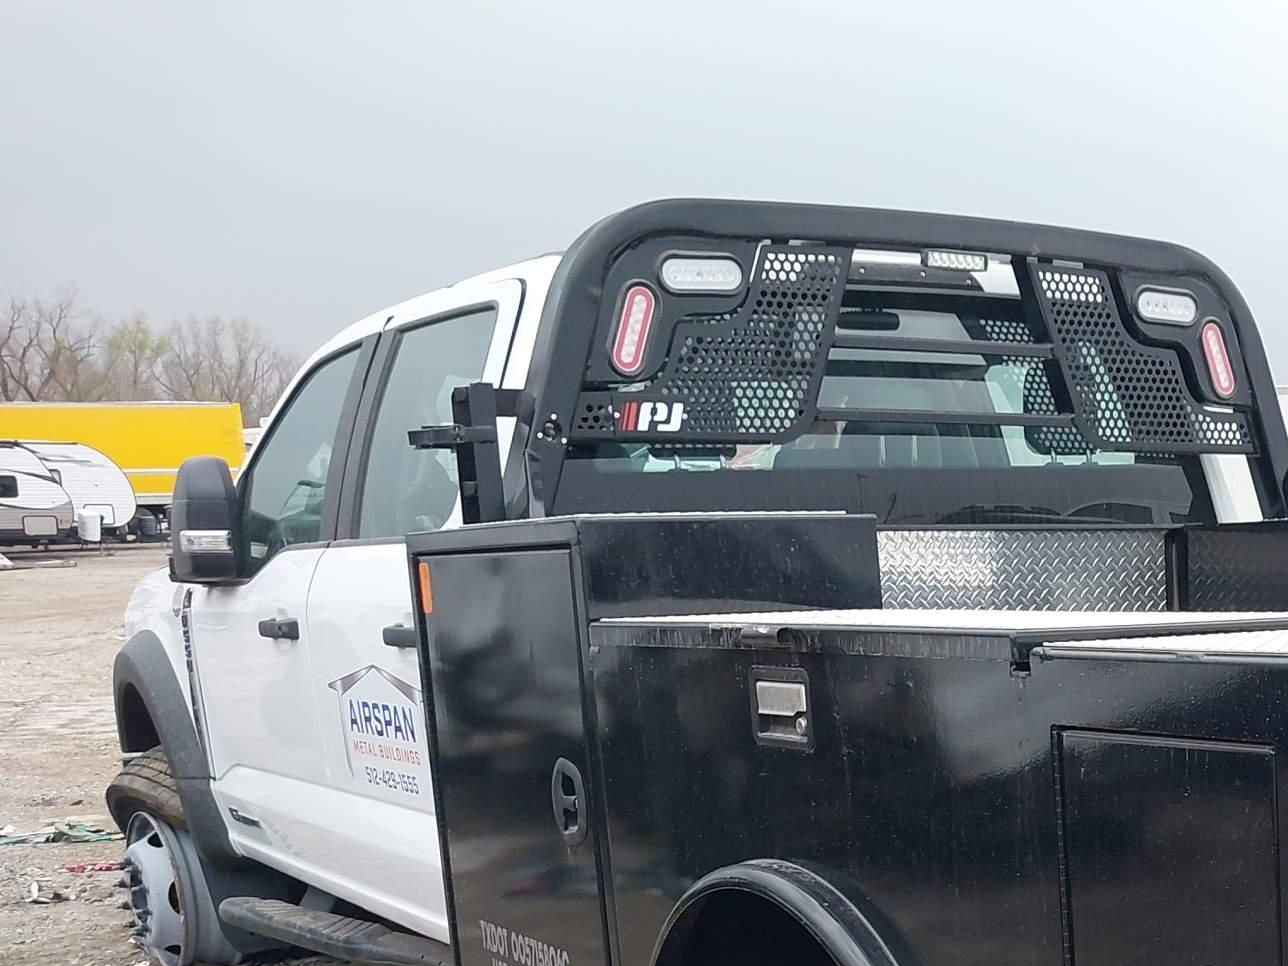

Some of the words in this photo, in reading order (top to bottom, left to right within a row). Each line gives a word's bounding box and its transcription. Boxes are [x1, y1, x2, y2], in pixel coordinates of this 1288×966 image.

[637, 401, 684, 432] PJ
[349, 699, 417, 743] AIRSPAN
[352, 739, 378, 757] METAL
[379, 744, 421, 766] BUILDINGS
[365, 766, 419, 795] 512-429-1555
[480, 920, 509, 958] TXDOT
